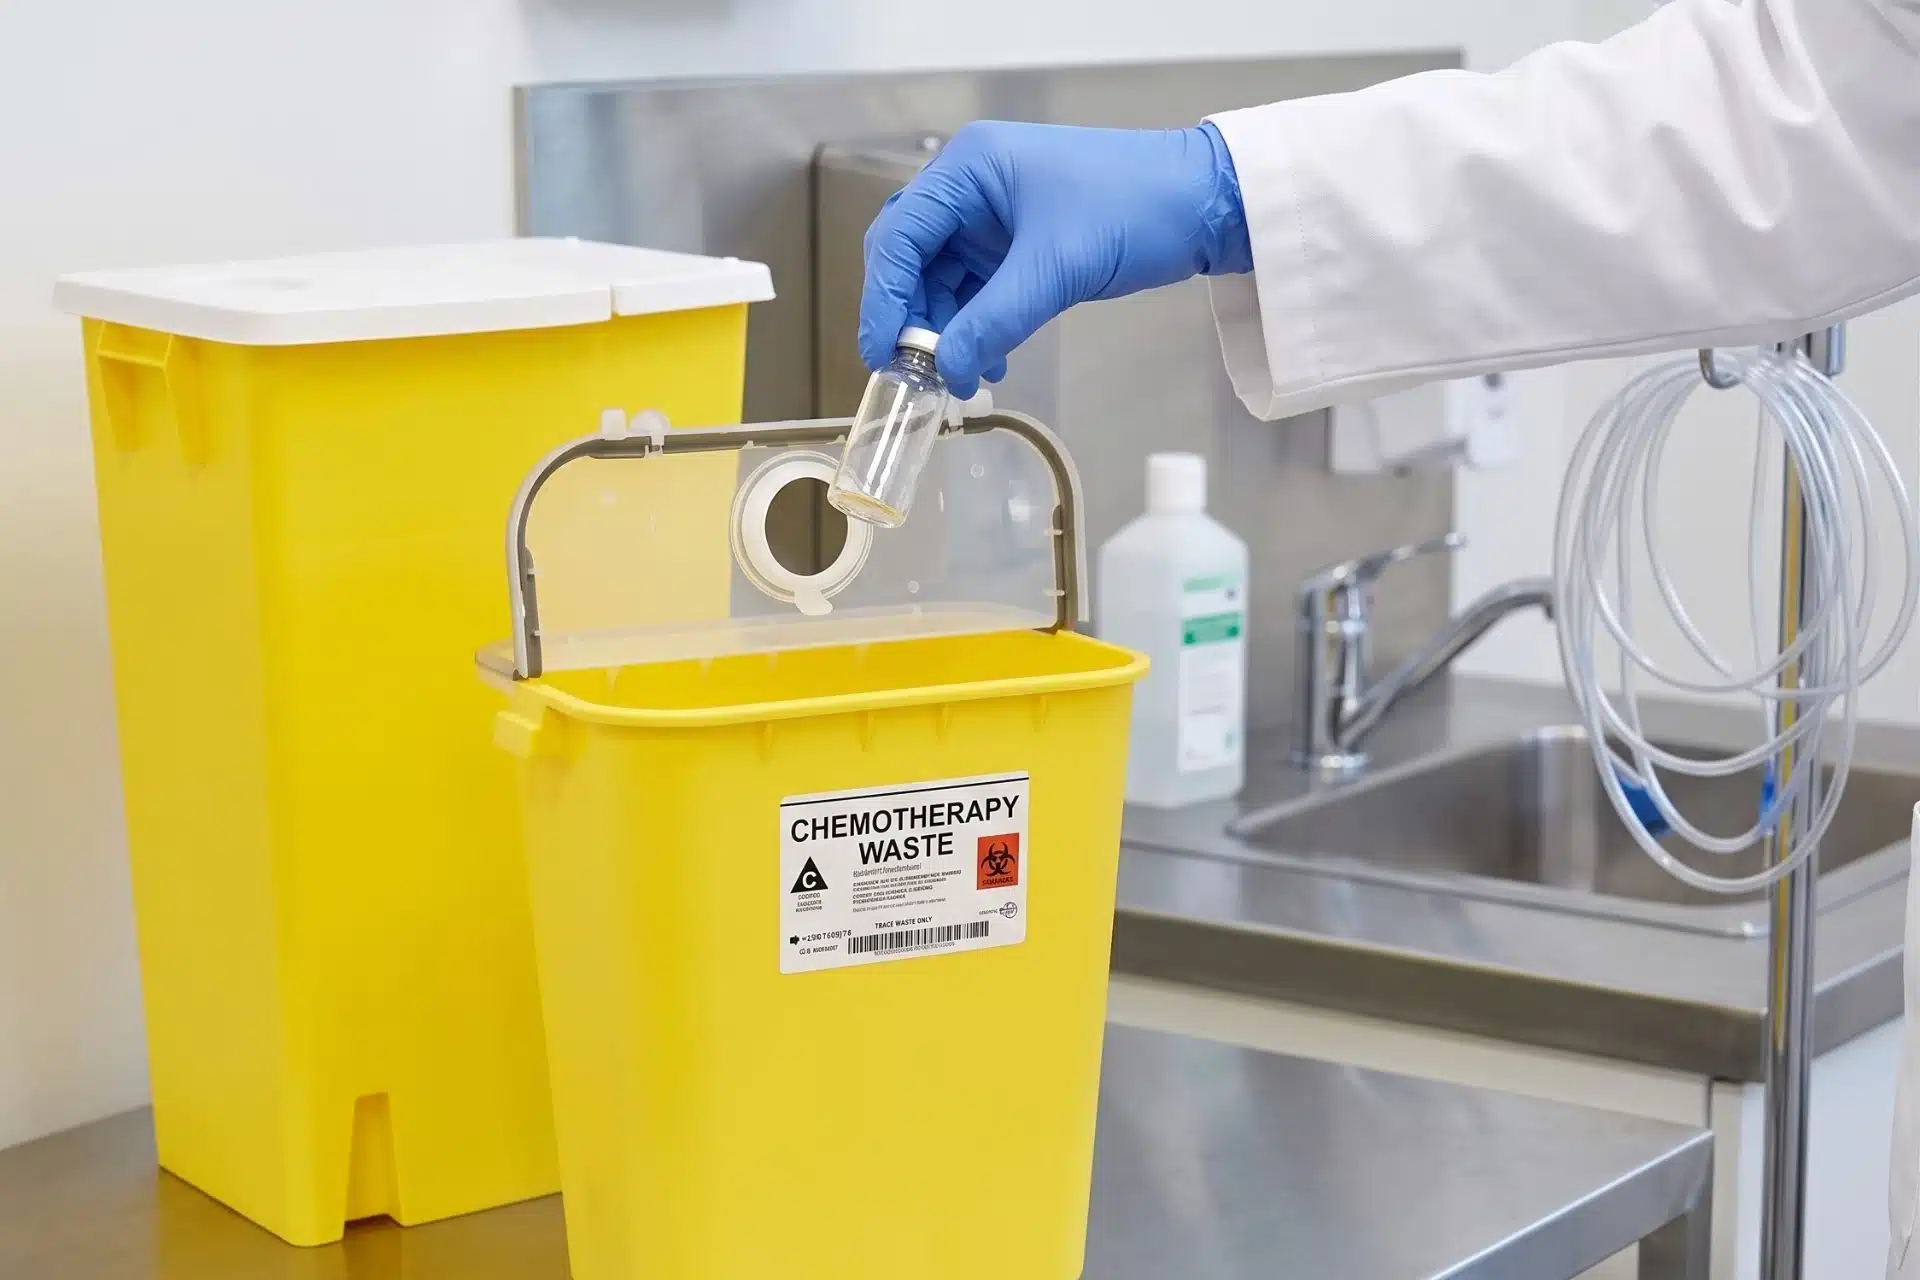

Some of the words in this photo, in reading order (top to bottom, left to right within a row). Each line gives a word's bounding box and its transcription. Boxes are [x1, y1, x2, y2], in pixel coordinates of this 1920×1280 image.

[791, 795, 1020, 843] CHEMOTHERAPY
[858, 832, 954, 865] WASTE
[802, 871, 817, 889] C
[875, 921, 894, 929] TRACE
[895, 919, 916, 927] WASTE
[917, 916, 933, 924] ONLY
